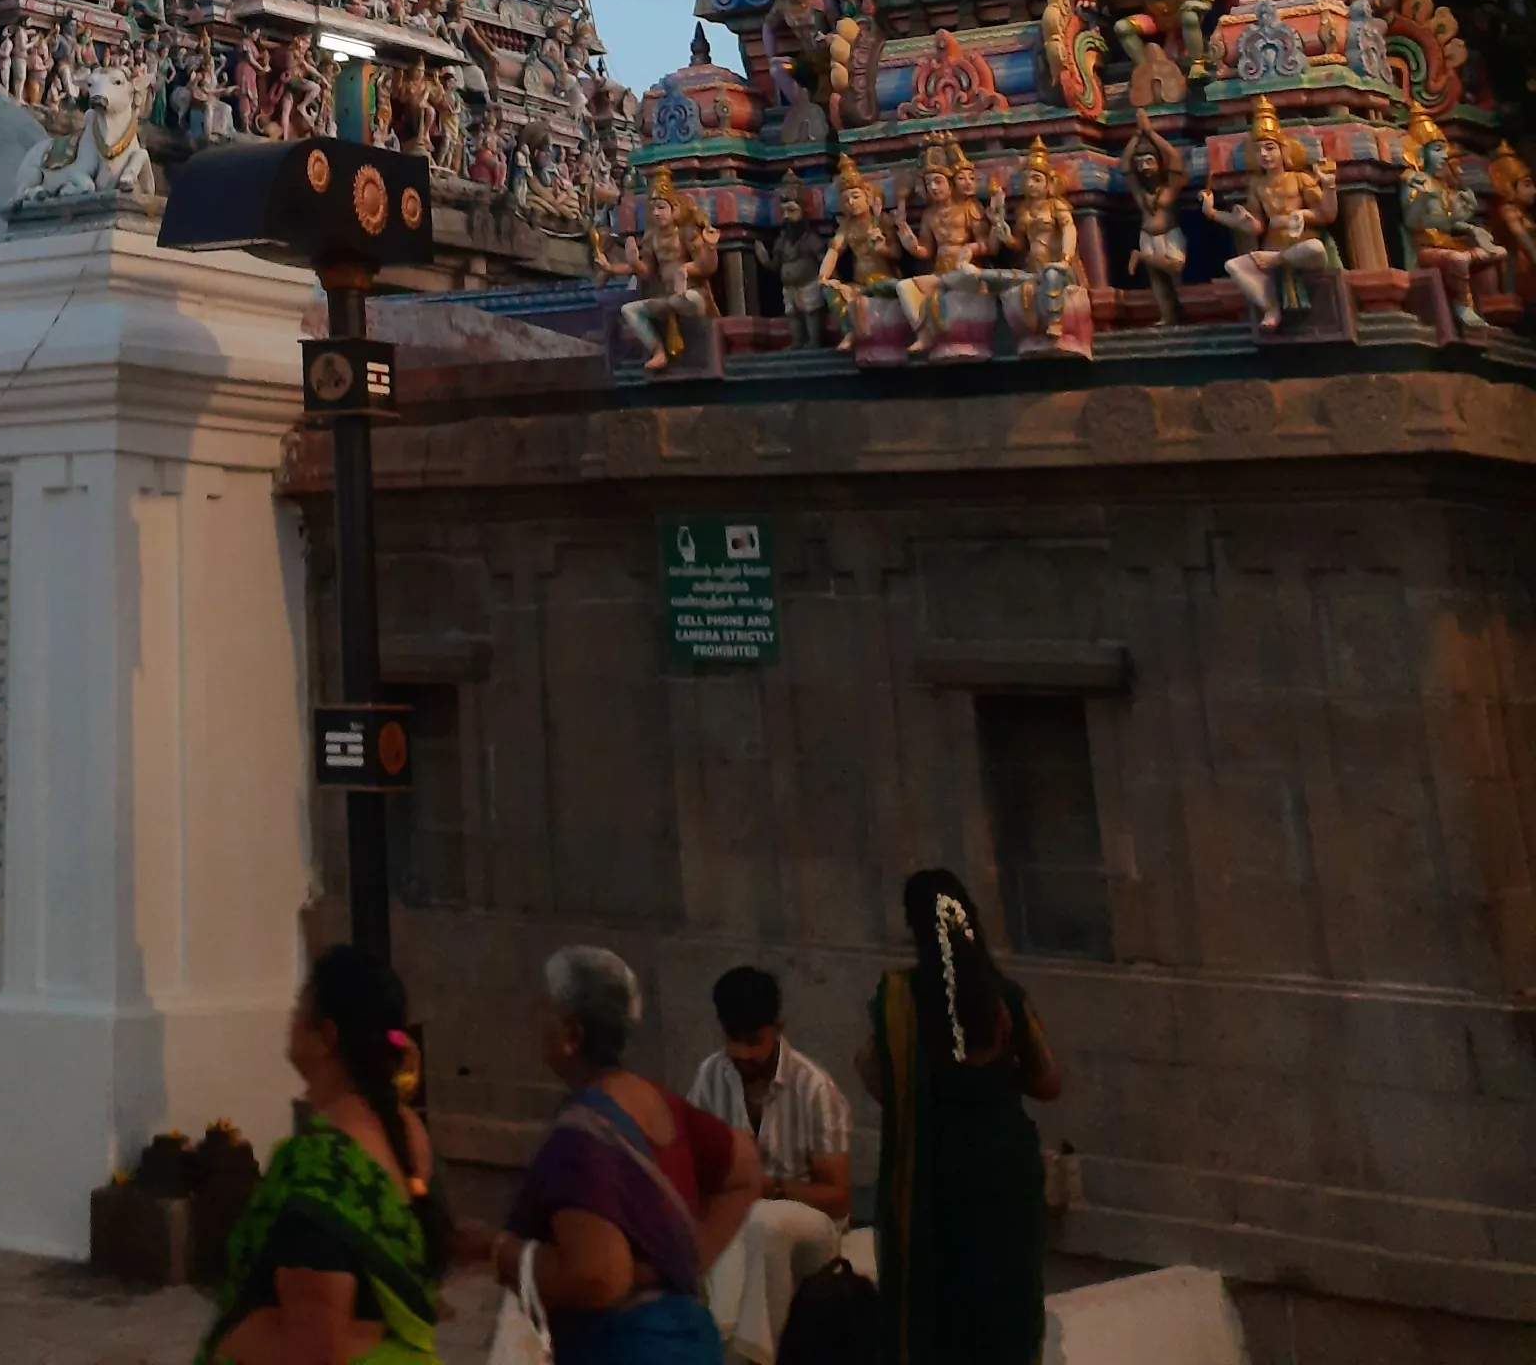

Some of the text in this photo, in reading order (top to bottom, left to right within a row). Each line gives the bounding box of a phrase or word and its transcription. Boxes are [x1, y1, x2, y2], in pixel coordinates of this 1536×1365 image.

[677, 614, 771, 627] CELL PHONE AND
[675, 629, 775, 643] CAMERA STRICTLY
[692, 644, 760, 658] PROHIBITED
